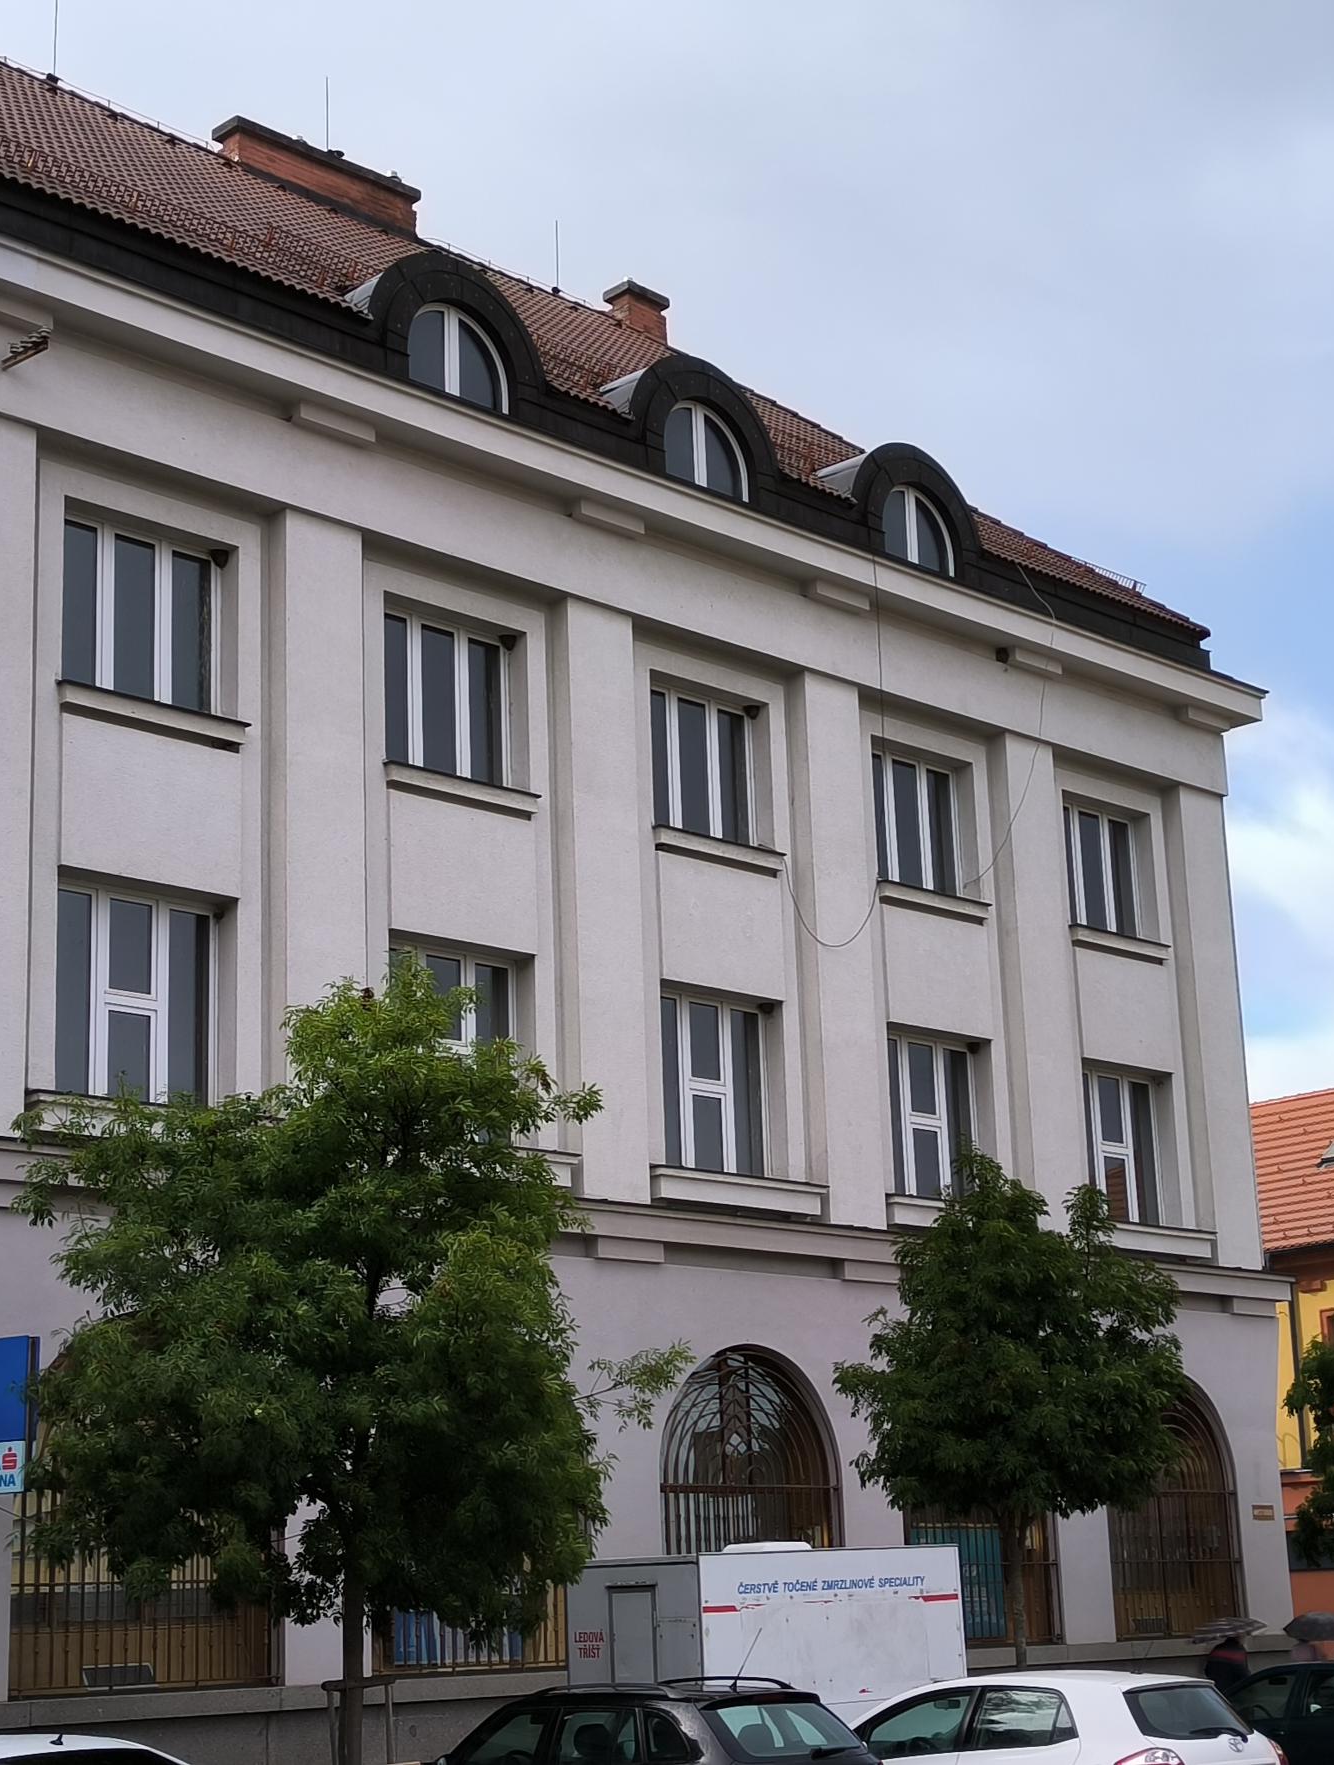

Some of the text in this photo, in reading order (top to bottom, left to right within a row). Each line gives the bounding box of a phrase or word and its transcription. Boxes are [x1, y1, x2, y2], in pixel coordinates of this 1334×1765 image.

[737, 1576, 925, 1595] ČERSTVĚ TOČENÉ ZMRZLINOVÉ SPECIALITY
[574, 1628, 605, 1643] LEDOVÁ
